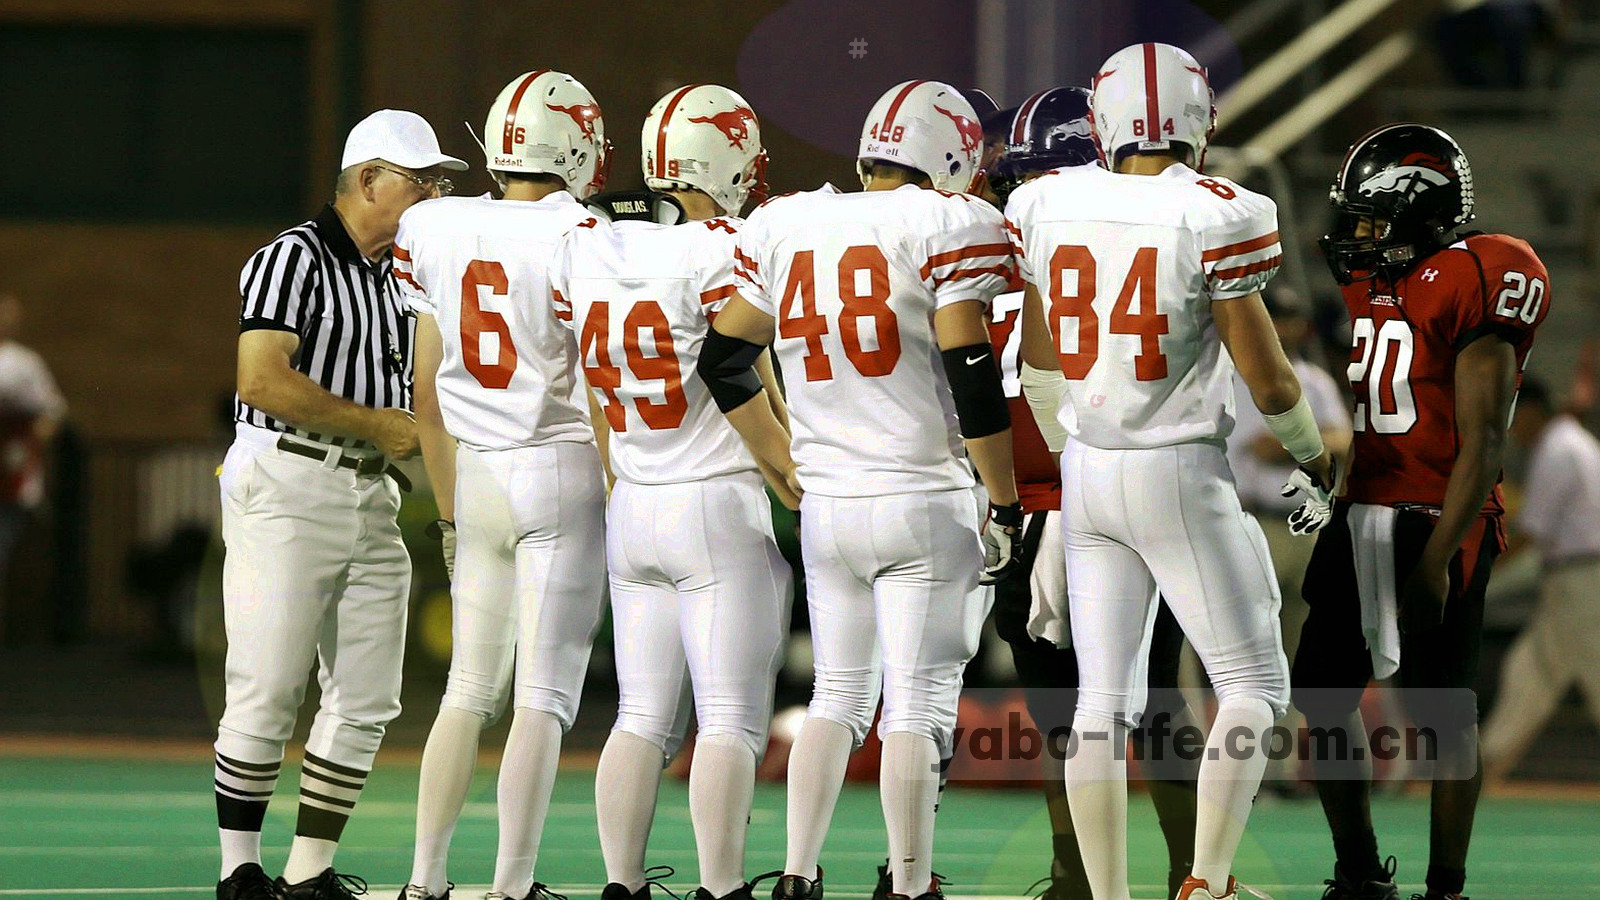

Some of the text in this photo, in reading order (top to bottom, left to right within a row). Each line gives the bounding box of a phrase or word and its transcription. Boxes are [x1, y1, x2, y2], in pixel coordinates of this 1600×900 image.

[867, 144, 899, 157] Ridell
[460, 259, 518, 389] 6
[779, 244, 902, 382] 48
[1049, 244, 1169, 381] 84
[1496, 270, 1545, 325] 20
[580, 300, 689, 432] 49
[1346, 318, 1417, 434] 20
